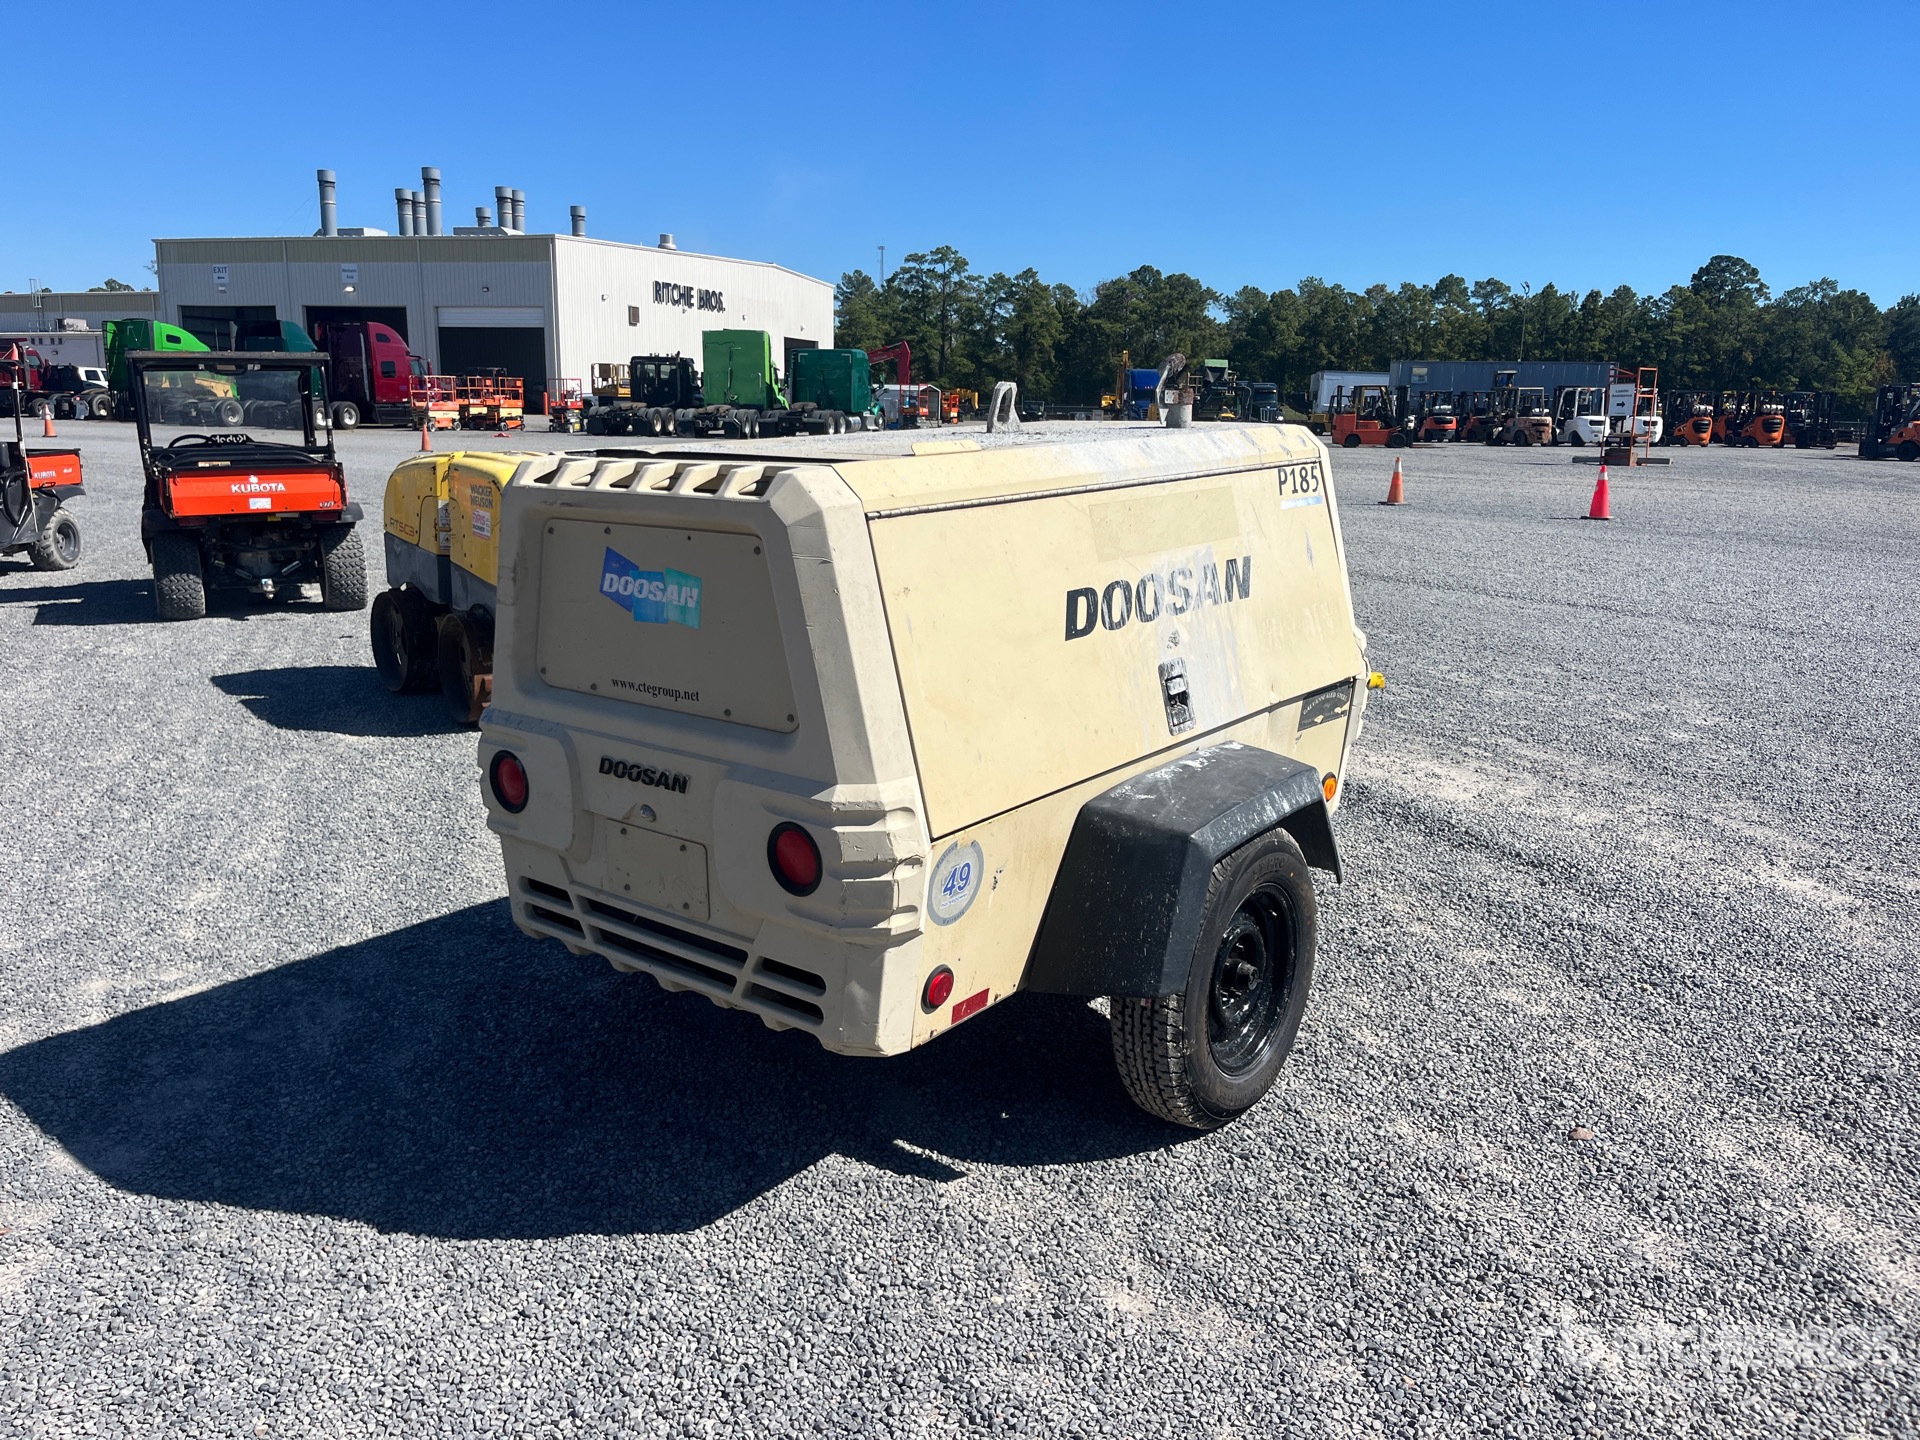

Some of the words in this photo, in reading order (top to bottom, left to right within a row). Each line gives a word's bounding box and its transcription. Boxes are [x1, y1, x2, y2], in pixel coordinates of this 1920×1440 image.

[213, 266, 228, 274] EXIT
[652, 280, 695, 309] RITCHIE
[697, 288, 726, 313] BROS.
[34, 470, 57, 479] KUBOTA
[231, 482, 286, 493] KUBOTA
[1277, 465, 1320, 496] P185
[470, 483, 493, 498] WACKER
[470, 494, 493, 509] NEUSON
[602, 572, 699, 608] DOOSAN
[1064, 554, 1252, 642] DOOSAN
[611, 678, 700, 702] www.ctegroup.net
[599, 755, 690, 794] DOOSAN
[943, 861, 971, 896] 49
